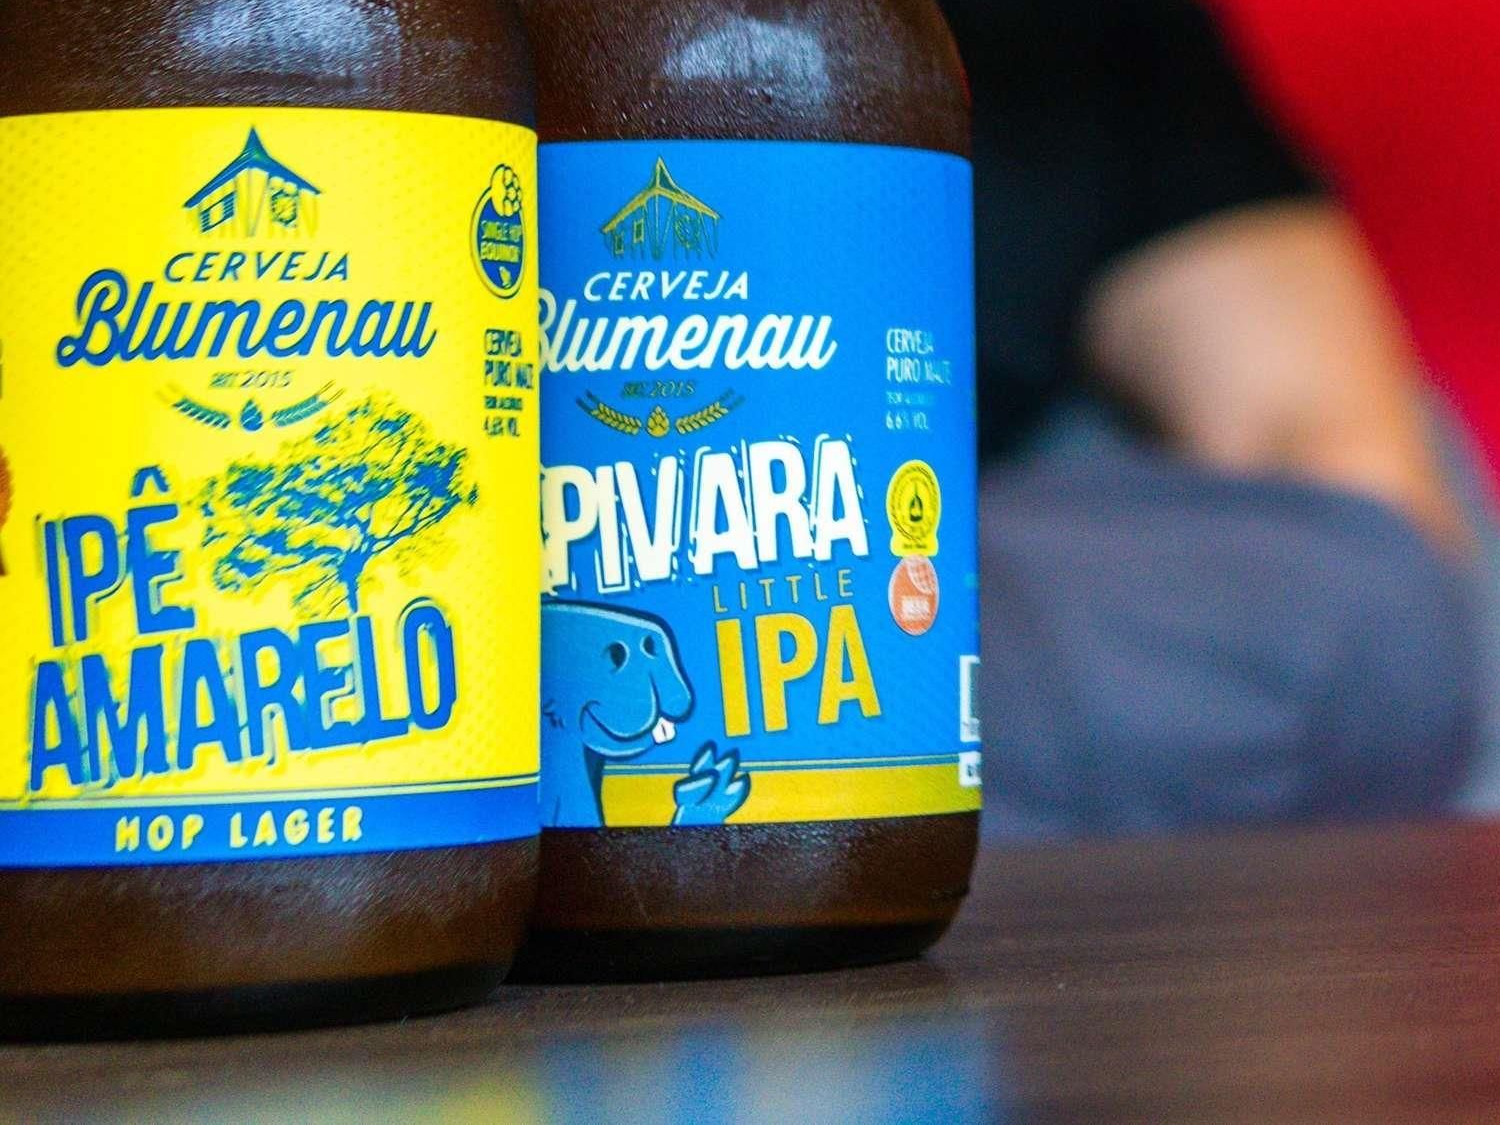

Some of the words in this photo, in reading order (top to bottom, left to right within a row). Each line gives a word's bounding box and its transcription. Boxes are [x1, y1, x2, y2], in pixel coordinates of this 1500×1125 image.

[164, 251, 350, 283] CERVEJA
[584, 271, 749, 302] CERVEJA
[57, 268, 438, 368] Blumenau
[240, 370, 294, 387] 2015
[650, 380, 696, 397] 2015
[886, 356, 921, 383] PURO
[540, 437, 869, 594] PIVARA
[43, 465, 195, 647] IPÊ
[712, 569, 854, 613] LITTLE
[715, 604, 882, 738] IPA
[30, 603, 457, 791] AMARELO
[115, 813, 205, 853] HOP
[229, 806, 364, 849] LAGER
